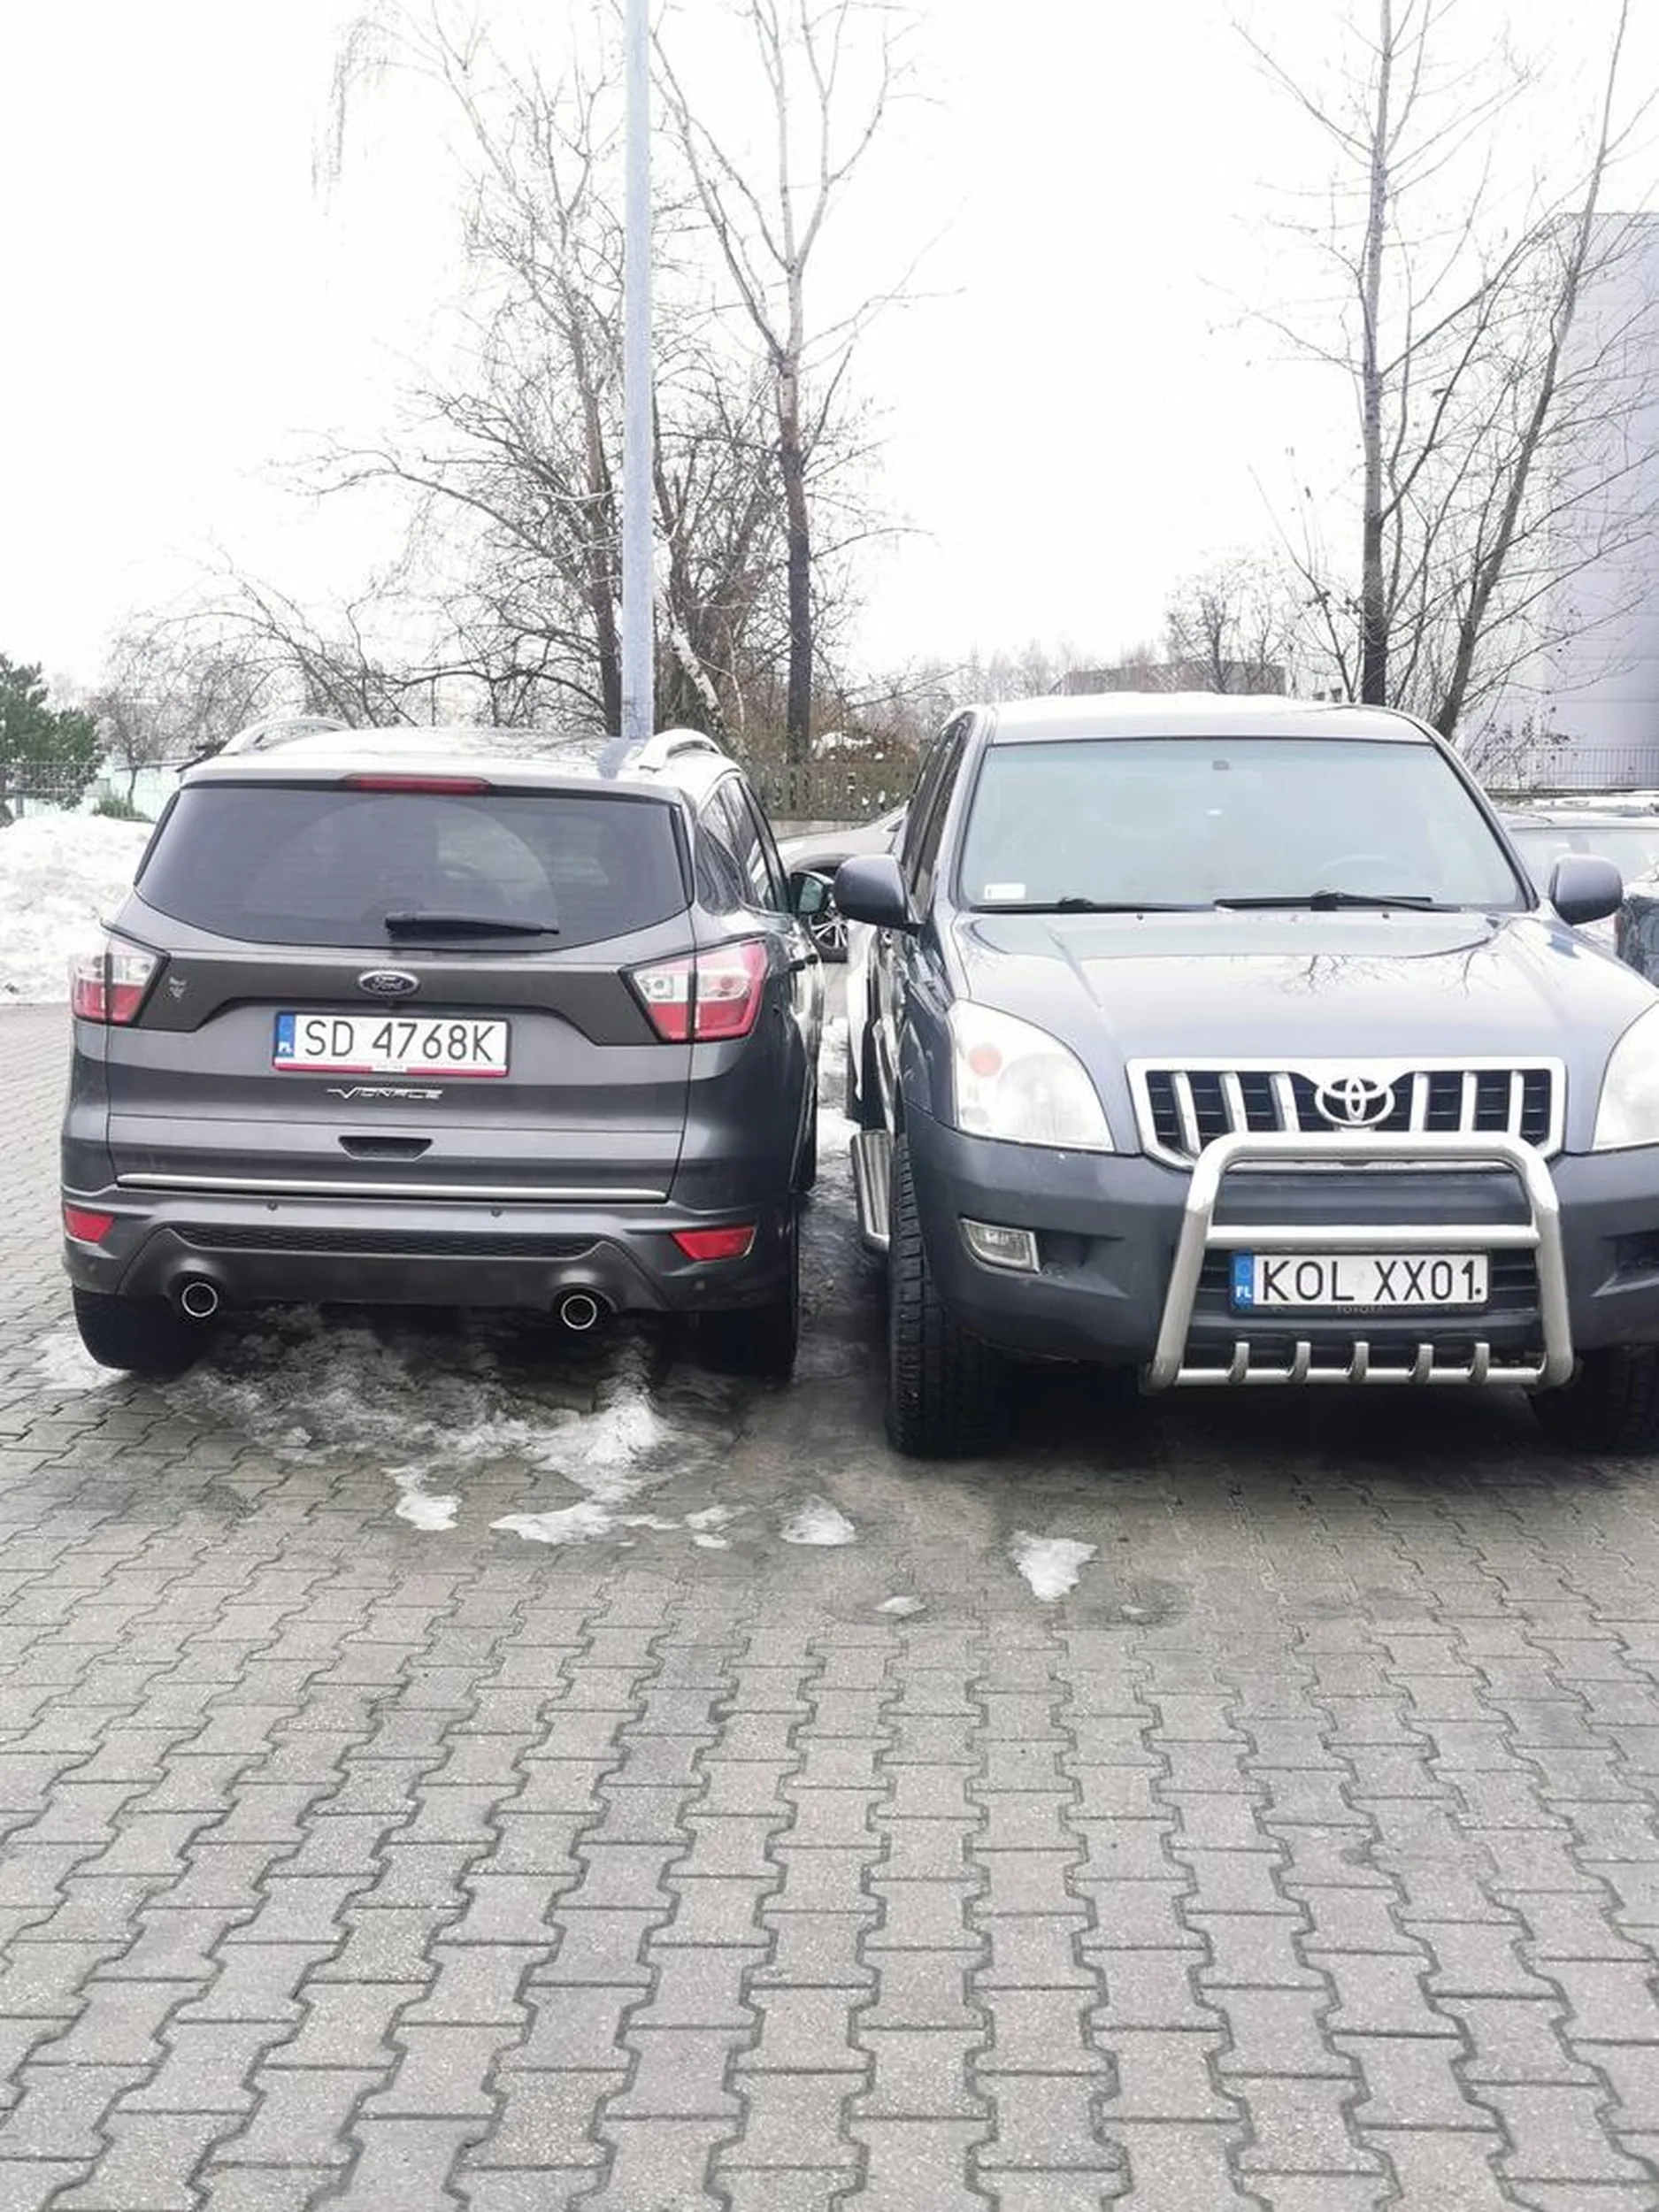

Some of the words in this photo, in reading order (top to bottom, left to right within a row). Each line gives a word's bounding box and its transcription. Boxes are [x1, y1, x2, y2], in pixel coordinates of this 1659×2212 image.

[372, 975, 404, 990] Ford
[305, 1020, 354, 1057] SD
[372, 1022, 496, 1062] 4768K
[1263, 1260, 1355, 1301] KOL
